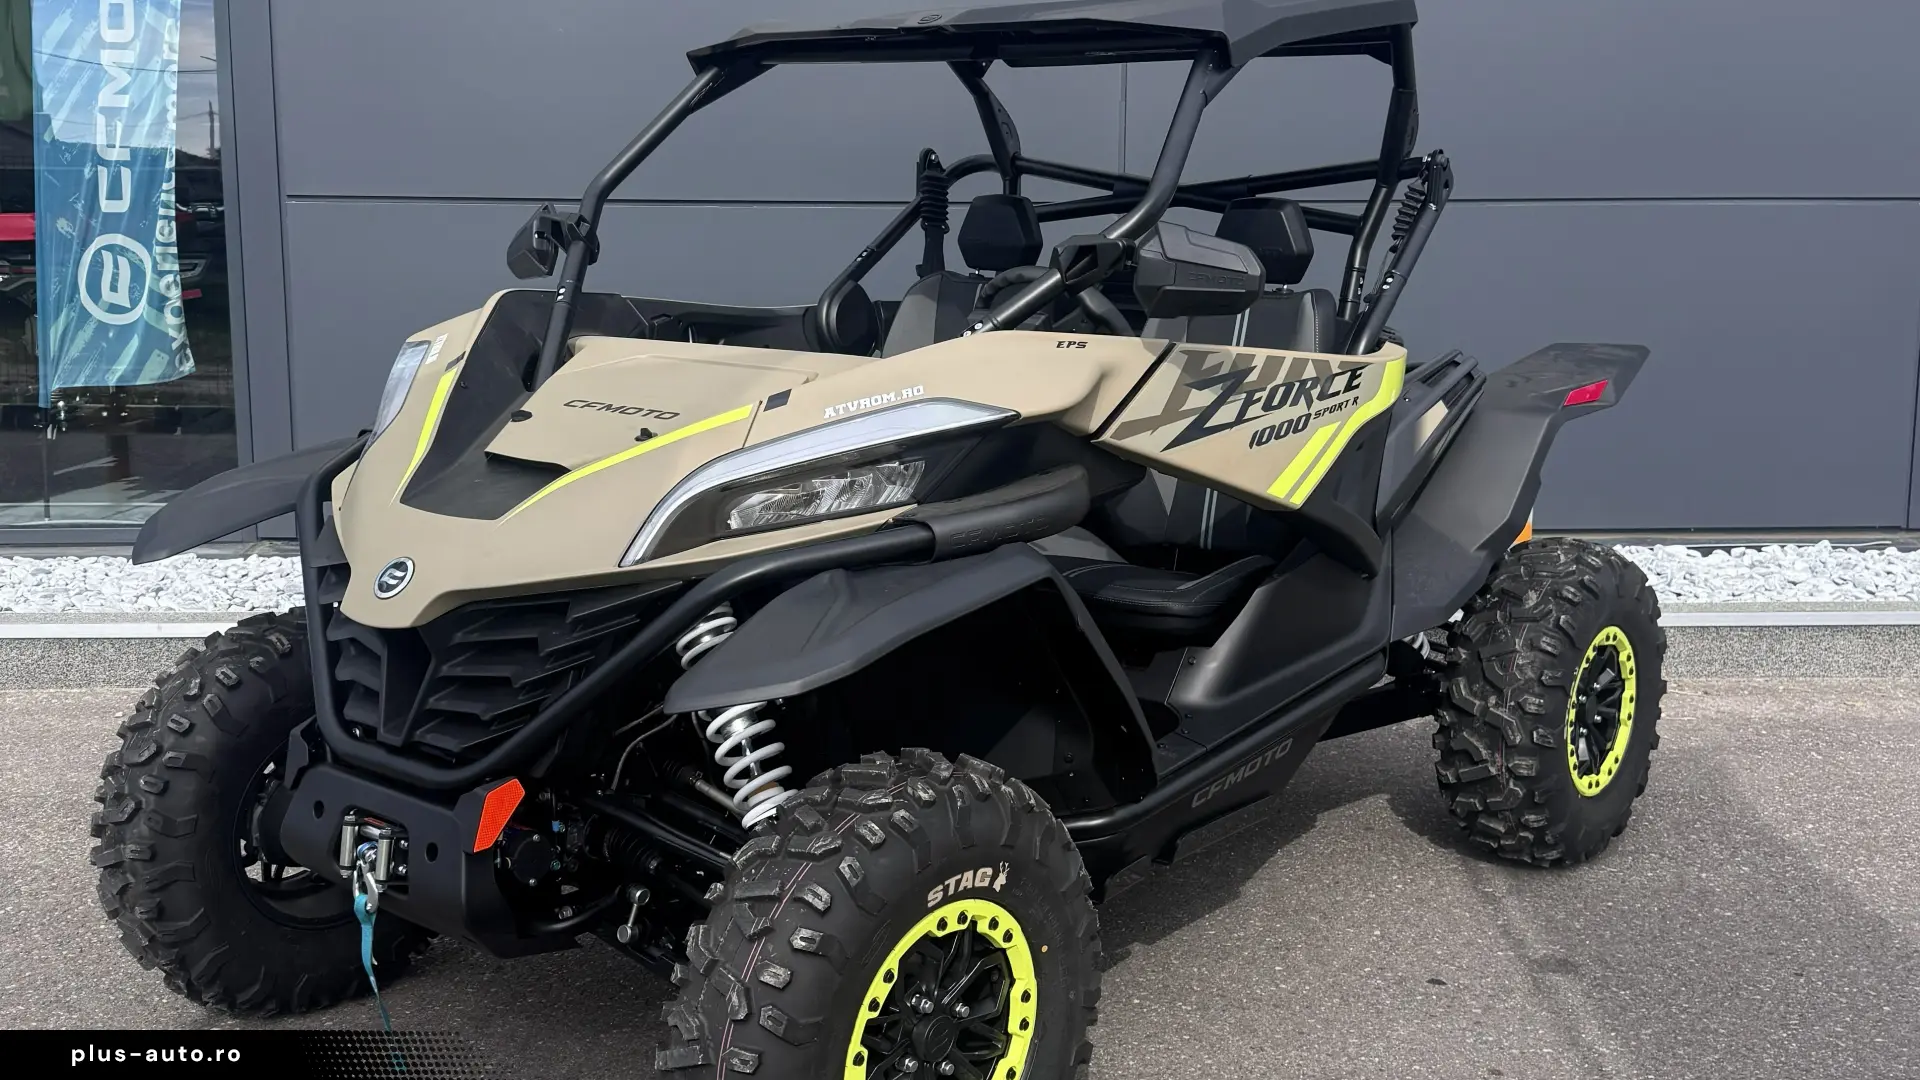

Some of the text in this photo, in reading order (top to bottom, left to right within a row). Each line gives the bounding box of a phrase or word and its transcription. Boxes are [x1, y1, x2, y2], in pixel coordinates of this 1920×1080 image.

[1056, 340, 1089, 350] EPS
[563, 398, 681, 420] CFMOTO
[823, 384, 925, 419] ATVROM.RO
[1249, 396, 1360, 449] 1000 SPORT R
[1191, 737, 1294, 808] CFMOTO
[926, 866, 994, 908] STAG
